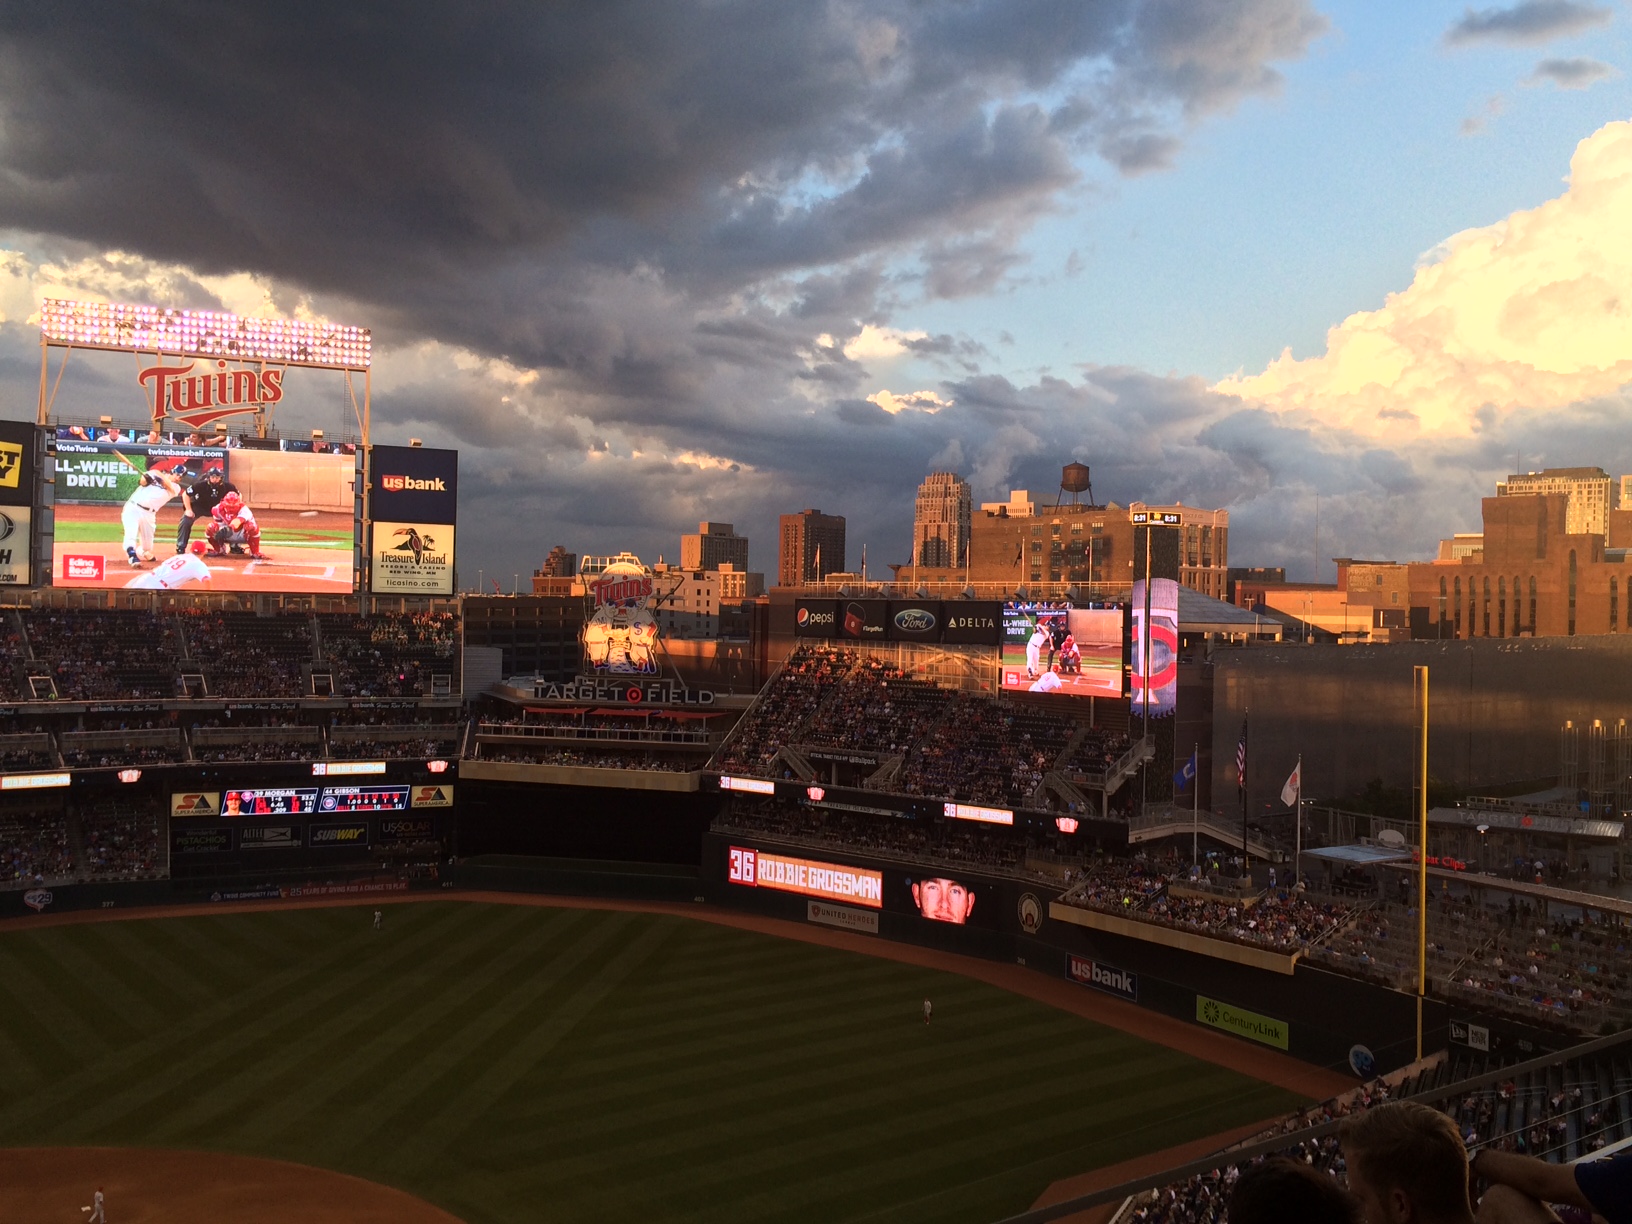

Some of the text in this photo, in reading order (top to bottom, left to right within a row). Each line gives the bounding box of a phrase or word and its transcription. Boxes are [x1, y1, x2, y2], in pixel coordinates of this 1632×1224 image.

[138, 360, 283, 422] Twins
[148, 448, 223, 457] twinsbaseball.com
[66, 474, 117, 488] DRIVE
[69, 558, 94, 567] Edina
[379, 551, 446, 565] Treasure Island
[386, 580, 439, 588] ticasino.com
[590, 575, 652, 609] Twins
[810, 611, 835, 626] pepsi
[901, 612, 927, 629] Ford
[960, 617, 994, 628] DELTA
[1007, 627, 1025, 635] DRIVE
[534, 684, 715, 705] TARGET FIELD
[313, 763, 326, 775] 36
[720, 776, 730, 789] 36
[174, 808, 215, 816] SUPERAMERICA
[944, 803, 956, 818] 36
[176, 836, 227, 846] PISTACHIOS
[313, 828, 365, 841] SUBWAY
[1441, 855, 1467, 871] Clips
[731, 849, 882, 900] 36 ROBBIE GROSSMAN
[290, 887, 302, 897] 25
[38, 893, 52, 905] 29
[821, 909, 876, 926] UNITED HEROES
[1222, 1010, 1281, 1040] CenturyLink
